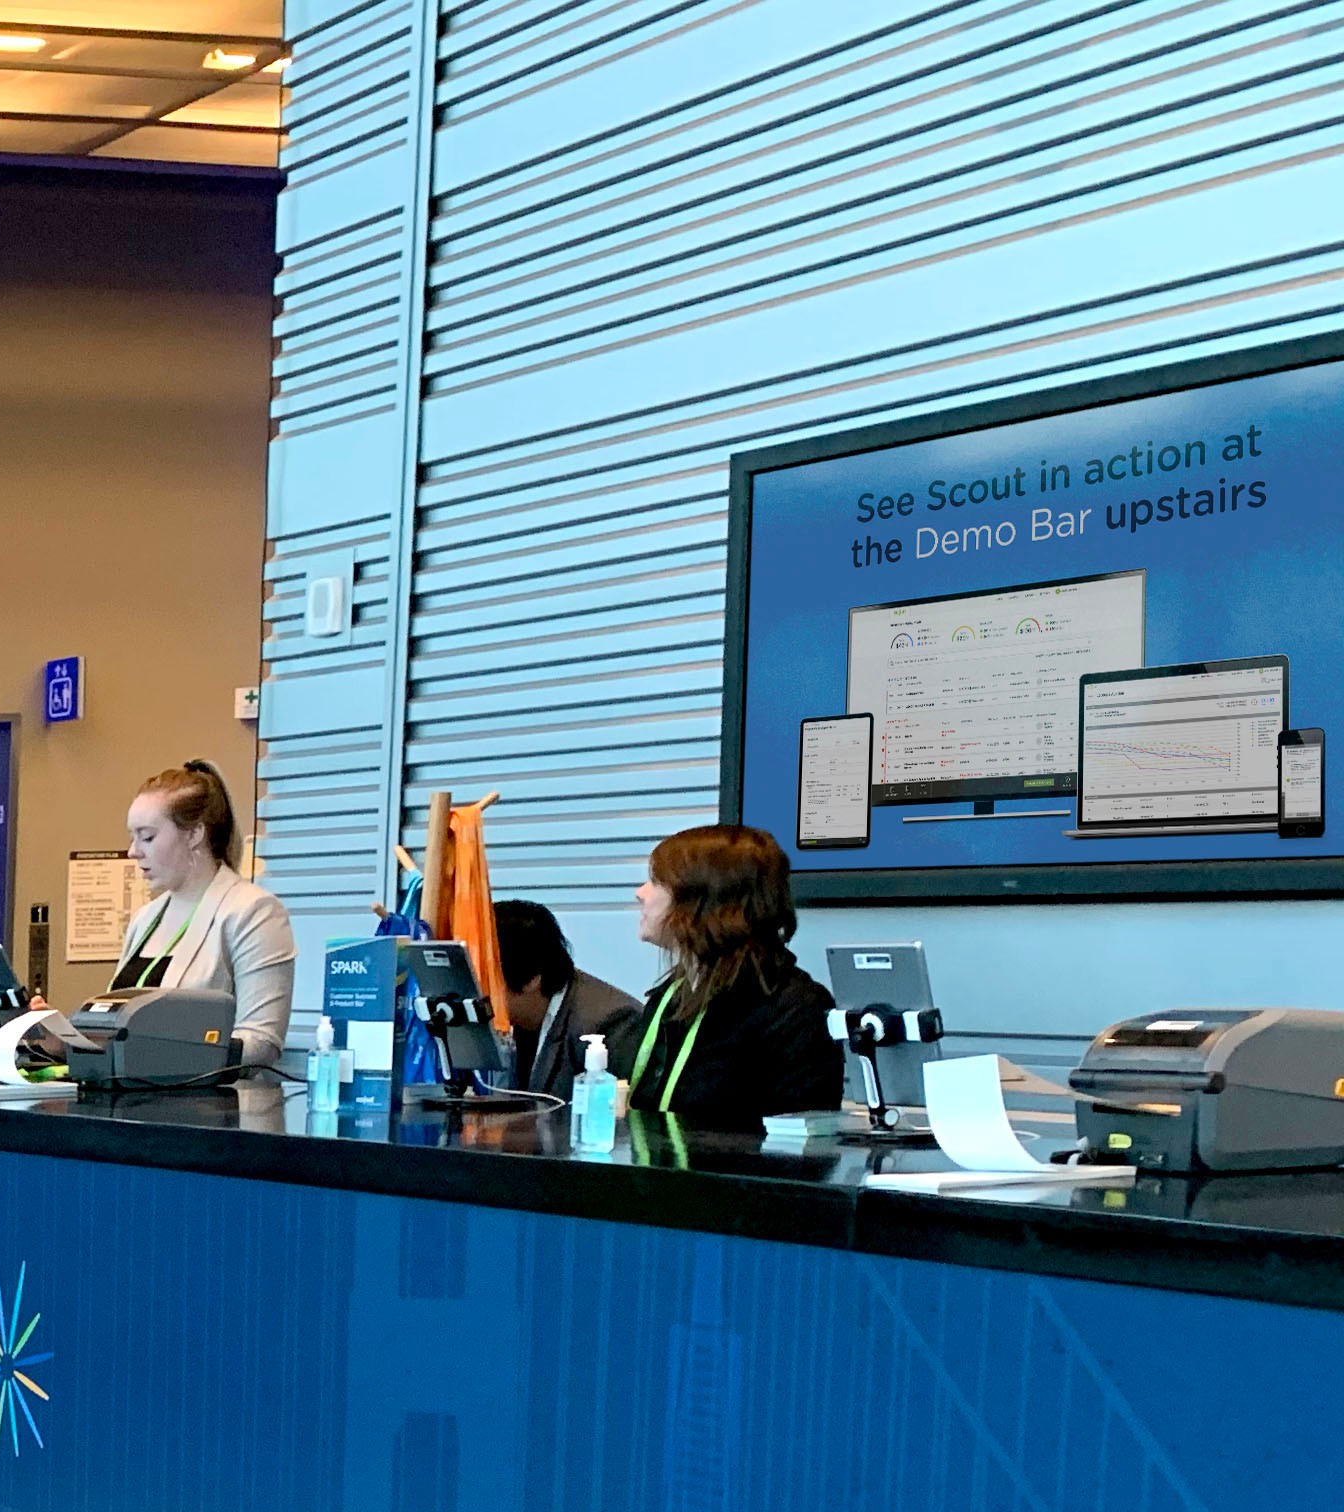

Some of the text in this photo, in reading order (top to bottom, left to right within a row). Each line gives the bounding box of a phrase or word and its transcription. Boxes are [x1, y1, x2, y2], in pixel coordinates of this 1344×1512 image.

[856, 425, 1262, 523] See Scout in action at
[852, 479, 1267, 568] the Demo Bar upstairs
[330, 960, 368, 975] SPARK
